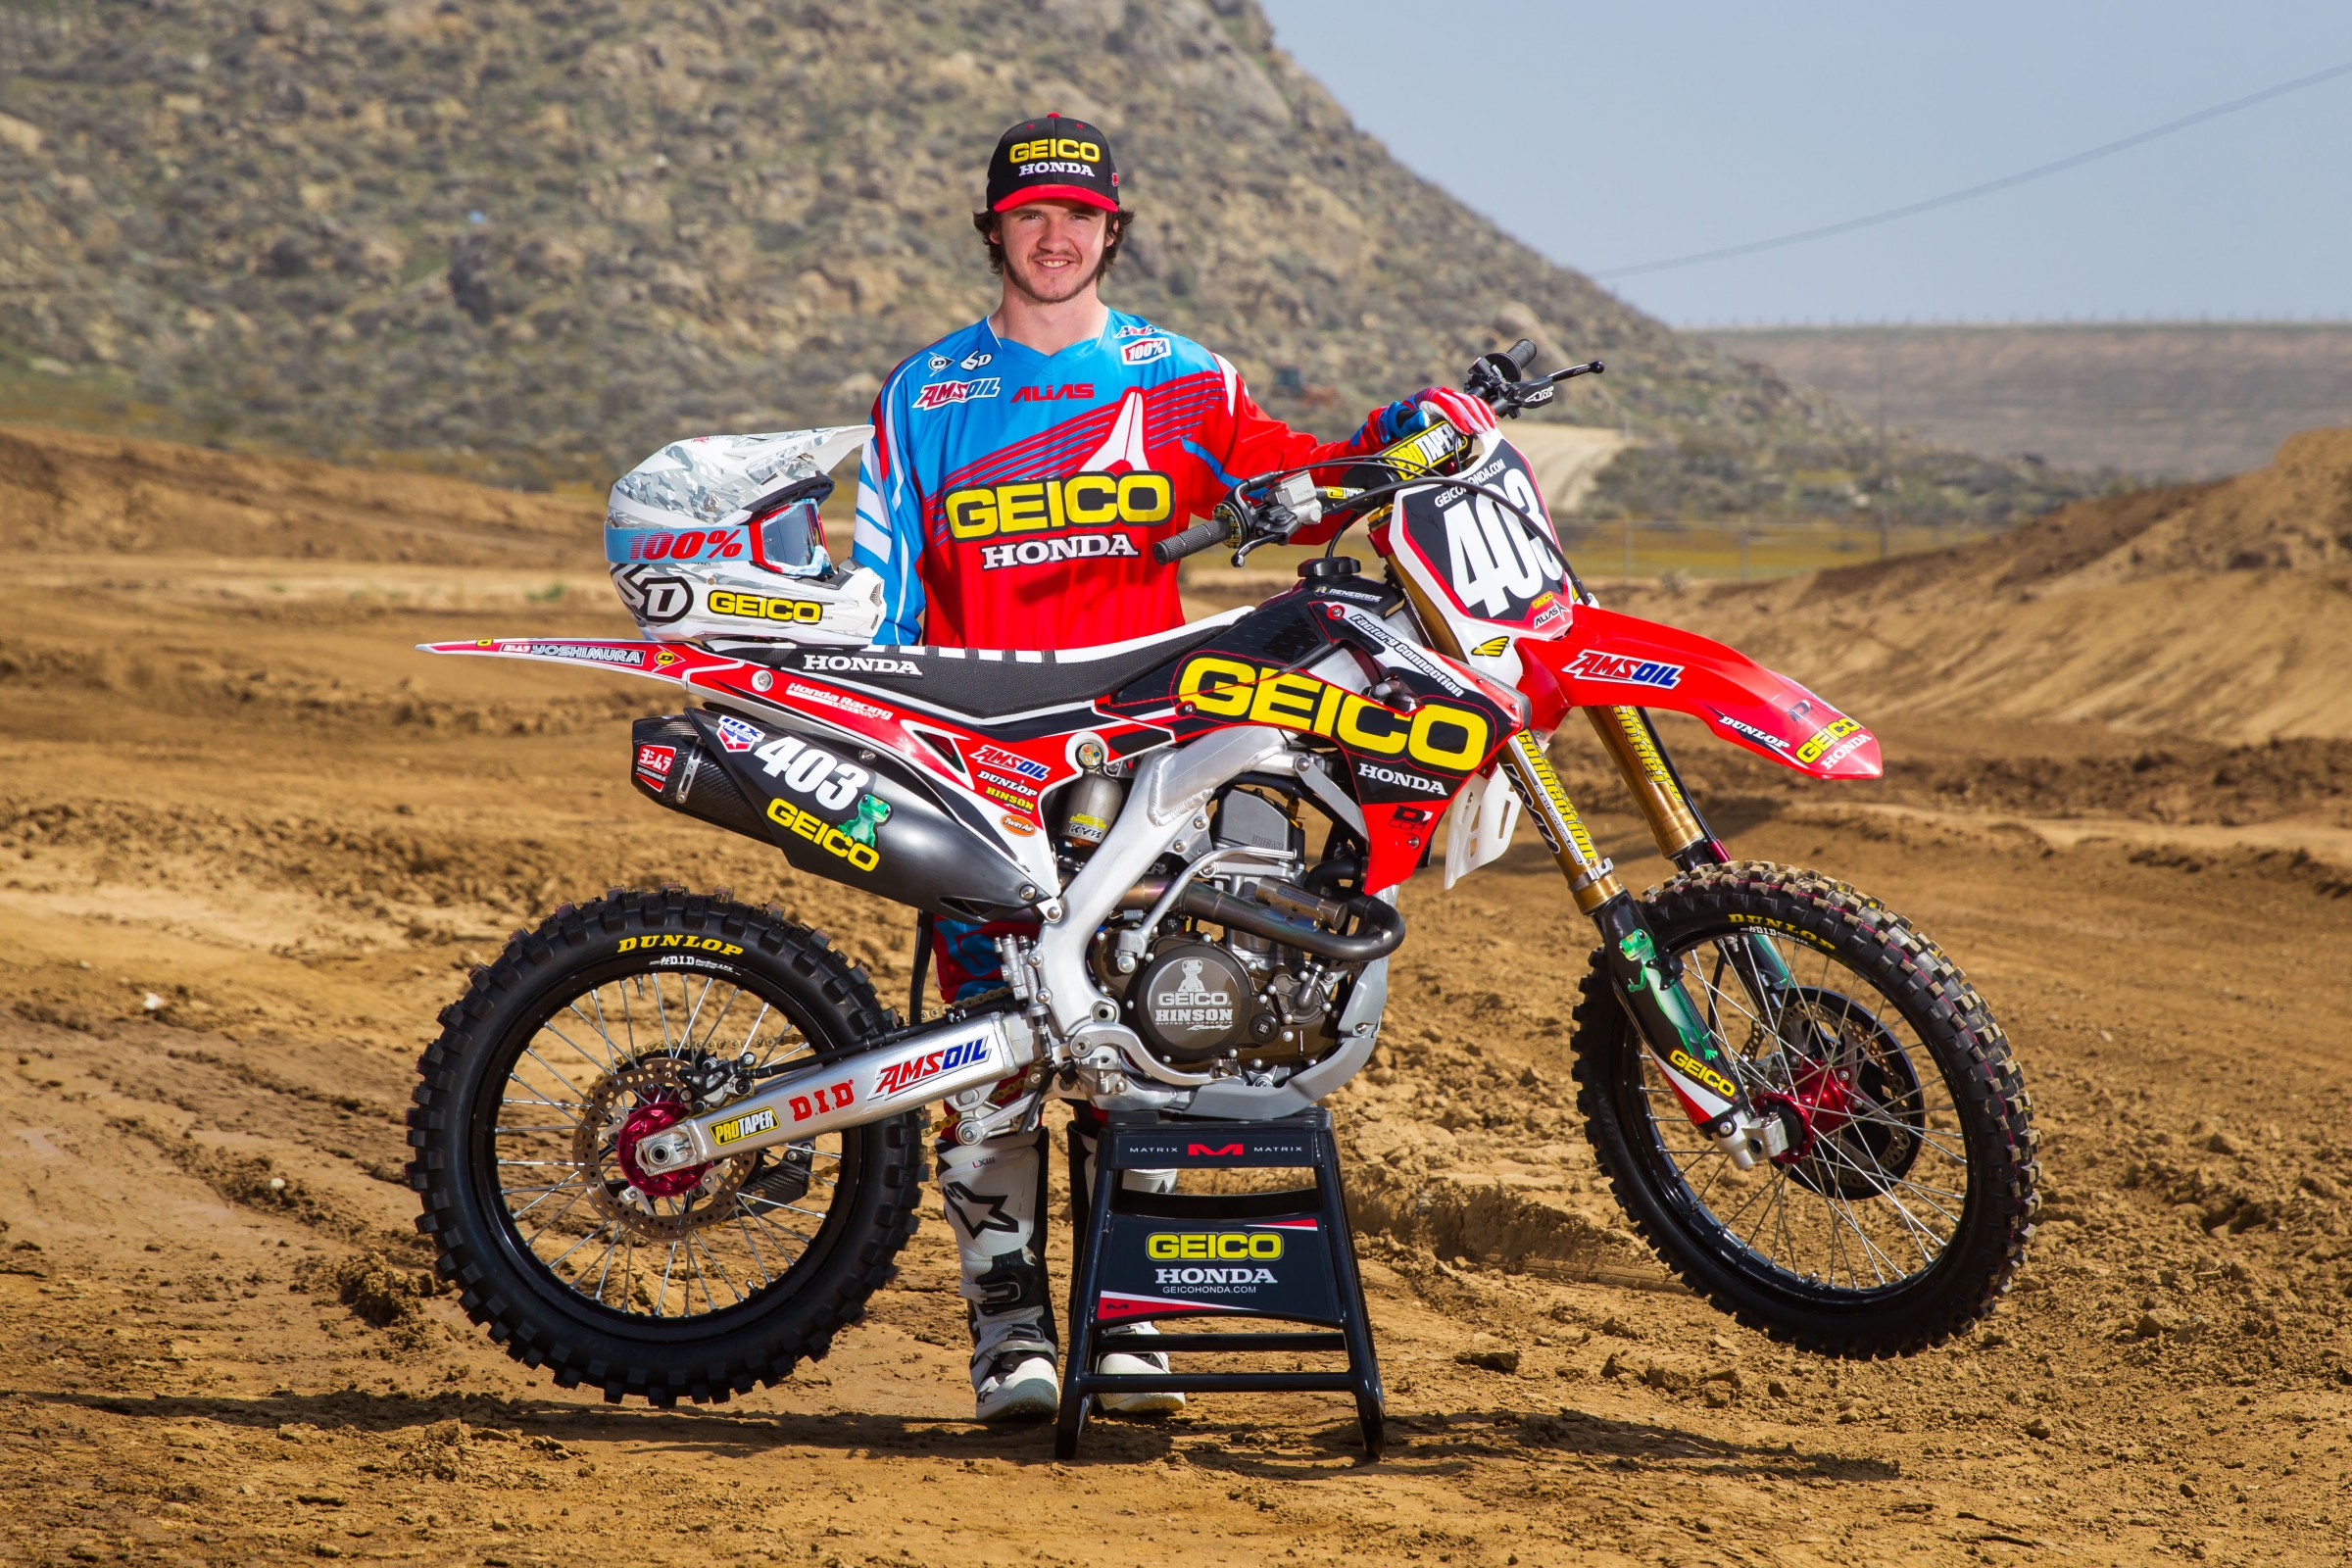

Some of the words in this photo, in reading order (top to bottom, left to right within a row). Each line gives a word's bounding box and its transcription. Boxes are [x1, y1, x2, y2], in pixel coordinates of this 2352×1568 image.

[1009, 138, 1100, 164] GEICO
[1019, 162, 1095, 177] HONDA
[960, 350, 993, 370] 6D
[1129, 341, 1165, 361] 100%
[916, 379, 1000, 409] AMSOIL
[1525, 386, 1554, 403] ARC
[1434, 458, 1506, 508] GEICOONDA.COM
[946, 474, 1170, 538] GEICO
[627, 529, 743, 561] 100%
[982, 533, 1138, 568] HONDA
[1444, 468, 1563, 618] 403
[709, 592, 821, 623] GEICO
[530, 645, 643, 664] YOSHIMURA
[803, 655, 922, 675] HONDA
[1565, 651, 1684, 689] AMSOIL
[787, 683, 839, 702] Honda
[840, 696, 893, 720] Racing
[1179, 658, 1488, 770] GEICO
[1612, 706, 1666, 783] Factor
[1719, 715, 1790, 749] DUNLOP
[1796, 718, 1861, 763] GEICO
[972, 745, 1050, 781] AMSOIL
[1820, 734, 1873, 770] HONDA
[754, 736, 870, 810] 403
[978, 770, 1038, 797] DUNLOP
[1358, 763, 1447, 796] HONDA
[986, 787, 1034, 810] HINSON
[766, 798, 879, 871] GEICO
[1004, 817, 1022, 829] Twin
[617, 935, 744, 956] DUNLOP
[1728, 913, 1836, 951] DUNLOP
[1155, 1009, 1233, 1021] HINSON
[1158, 992, 1229, 1006] GEICO
[868, 1037, 992, 1100] AMSOIL
[1670, 1049, 1736, 1098] GEICO
[789, 1083, 855, 1121] D.I.D
[714, 1110, 774, 1145] PROTAPER
[1147, 1234, 1283, 1259] GEICO
[1155, 1268, 1278, 1284] HONDA
